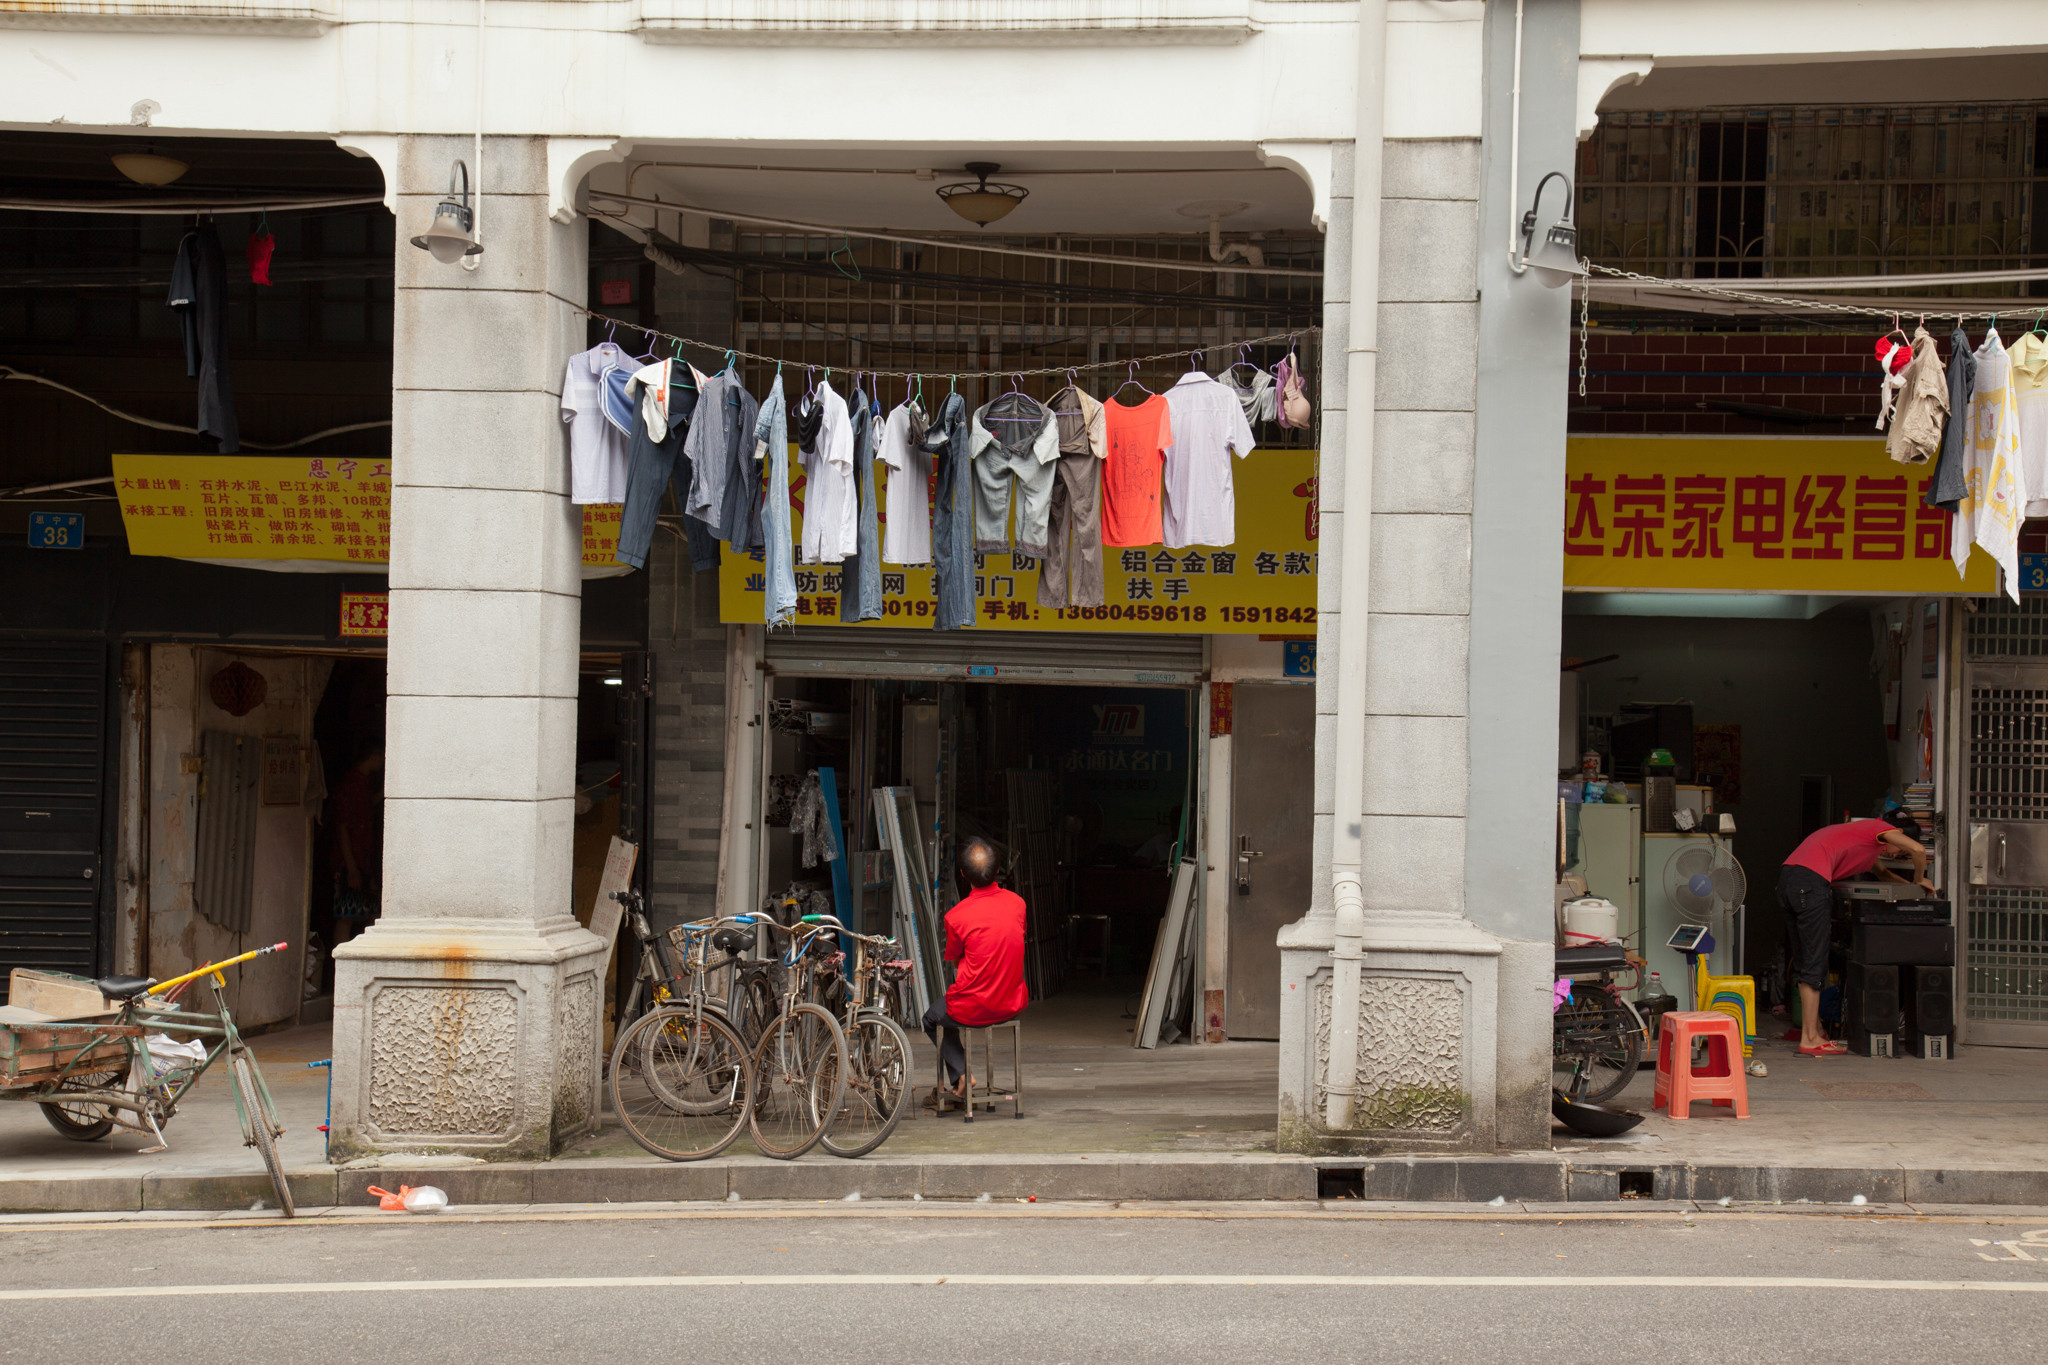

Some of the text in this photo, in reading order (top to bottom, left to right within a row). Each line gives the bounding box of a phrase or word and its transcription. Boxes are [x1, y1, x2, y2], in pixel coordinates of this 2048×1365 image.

[199, 480, 392, 493] 石井水泥、巴江水泥、羊城
[43, 526, 68, 546] 38
[584, 538, 620, 550] 信誉
[1121, 550, 1236, 574] 铝合金窗
[1254, 552, 1318, 575] 各款
[2031, 568, 2048, 588] 3
[1127, 578, 1190, 601] 扶手
[350, 604, 388, 627] 萬事
[1057, 604, 1207, 623] 13660459618
